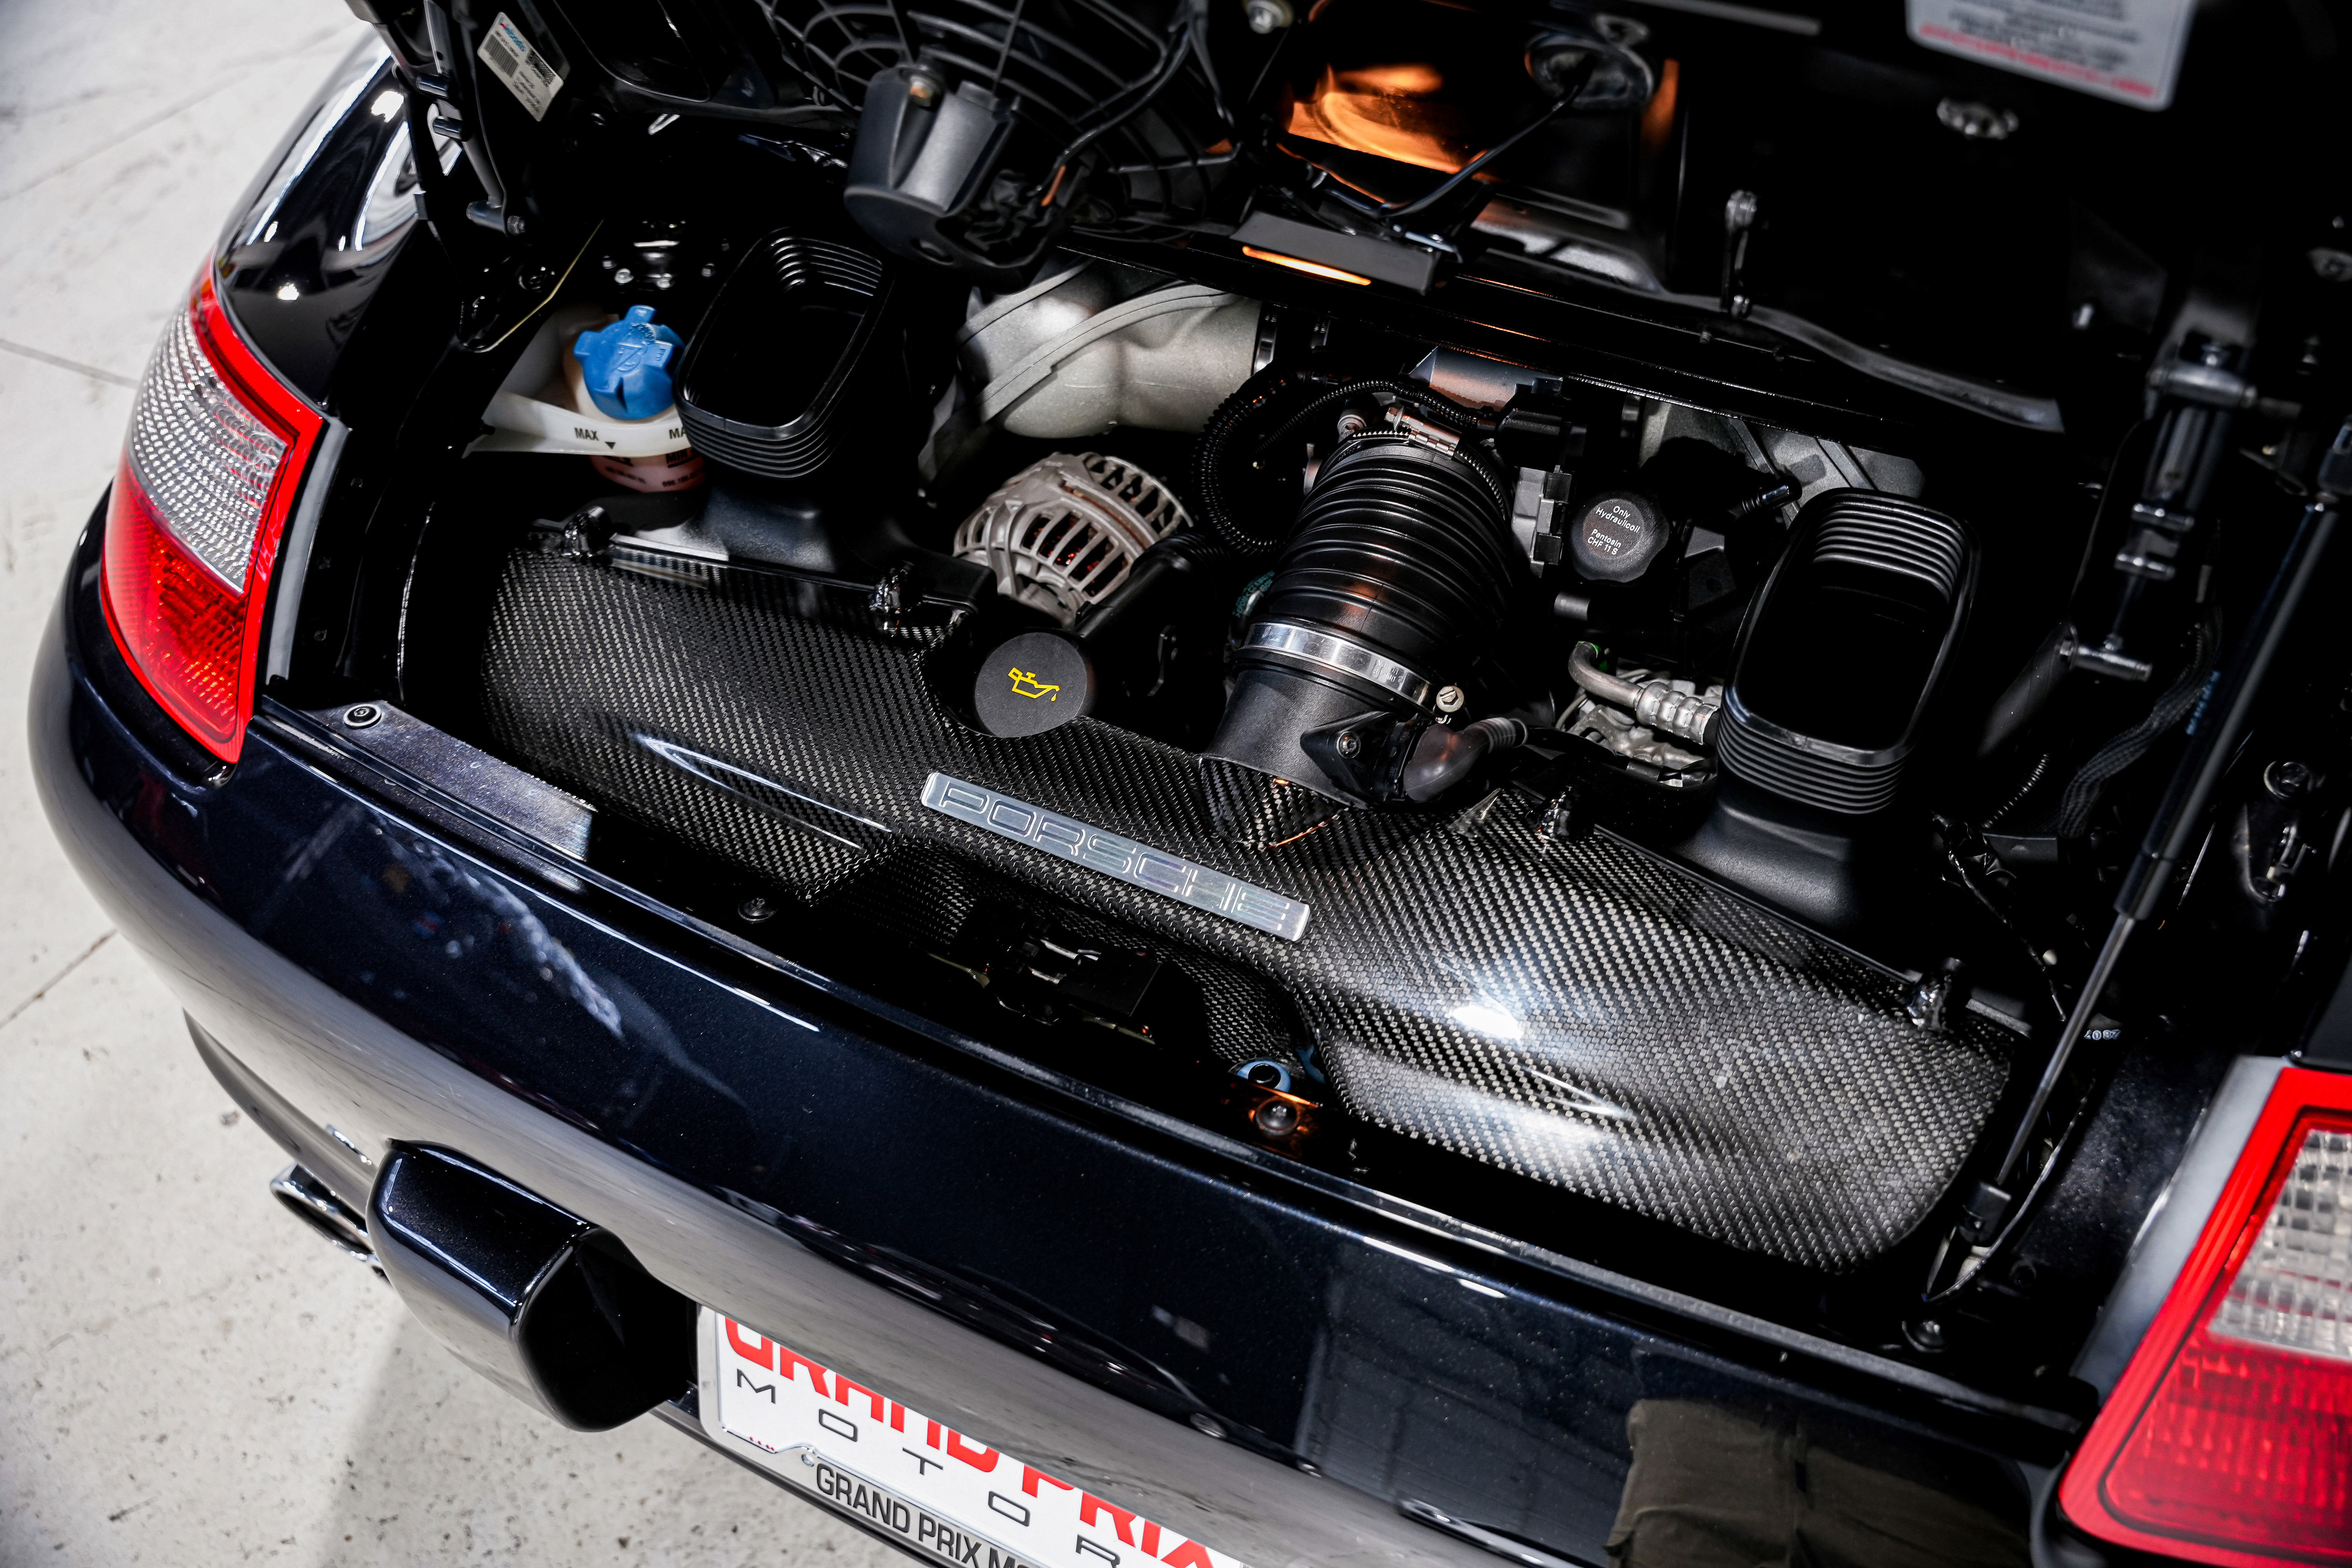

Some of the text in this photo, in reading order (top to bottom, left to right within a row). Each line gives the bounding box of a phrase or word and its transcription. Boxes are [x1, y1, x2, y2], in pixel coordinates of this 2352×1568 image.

[575, 428, 599, 441] MAX
[669, 427, 686, 439] MA
[665, 450, 687, 463] MIN
[1595, 507, 1641, 533] Hydraulicoil
[1613, 506, 1631, 519] Only
[1588, 537, 1604, 547] CHF
[1604, 544, 1612, 552] 11
[1591, 528, 1621, 548] Pentosin
[940, 781, 1290, 931] PORSCHE
[817, 1463, 911, 1533] GRAND
[919, 1512, 982, 1568] PRIX
